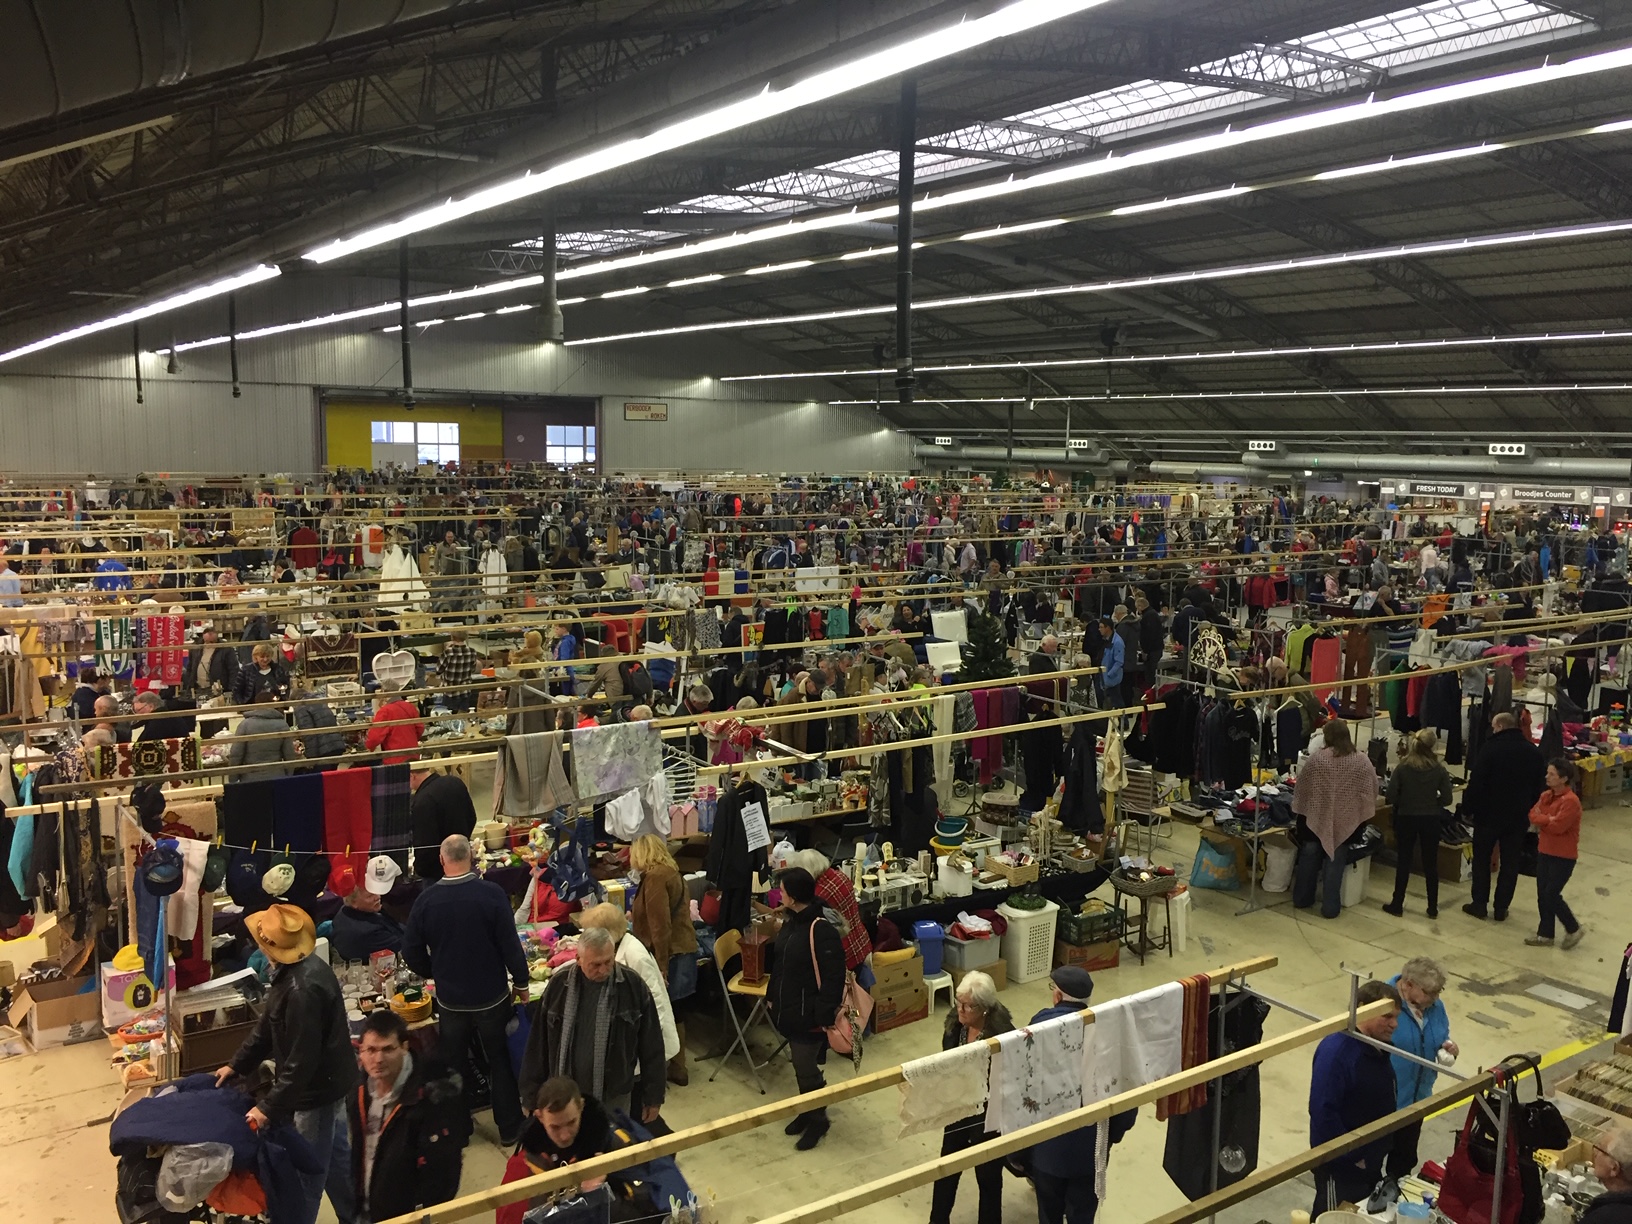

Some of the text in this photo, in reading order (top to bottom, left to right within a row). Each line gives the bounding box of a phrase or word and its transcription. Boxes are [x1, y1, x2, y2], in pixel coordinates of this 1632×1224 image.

[1416, 485, 1458, 494] FRESH TODAY
[1514, 489, 1572, 499] Broodjes Counter
